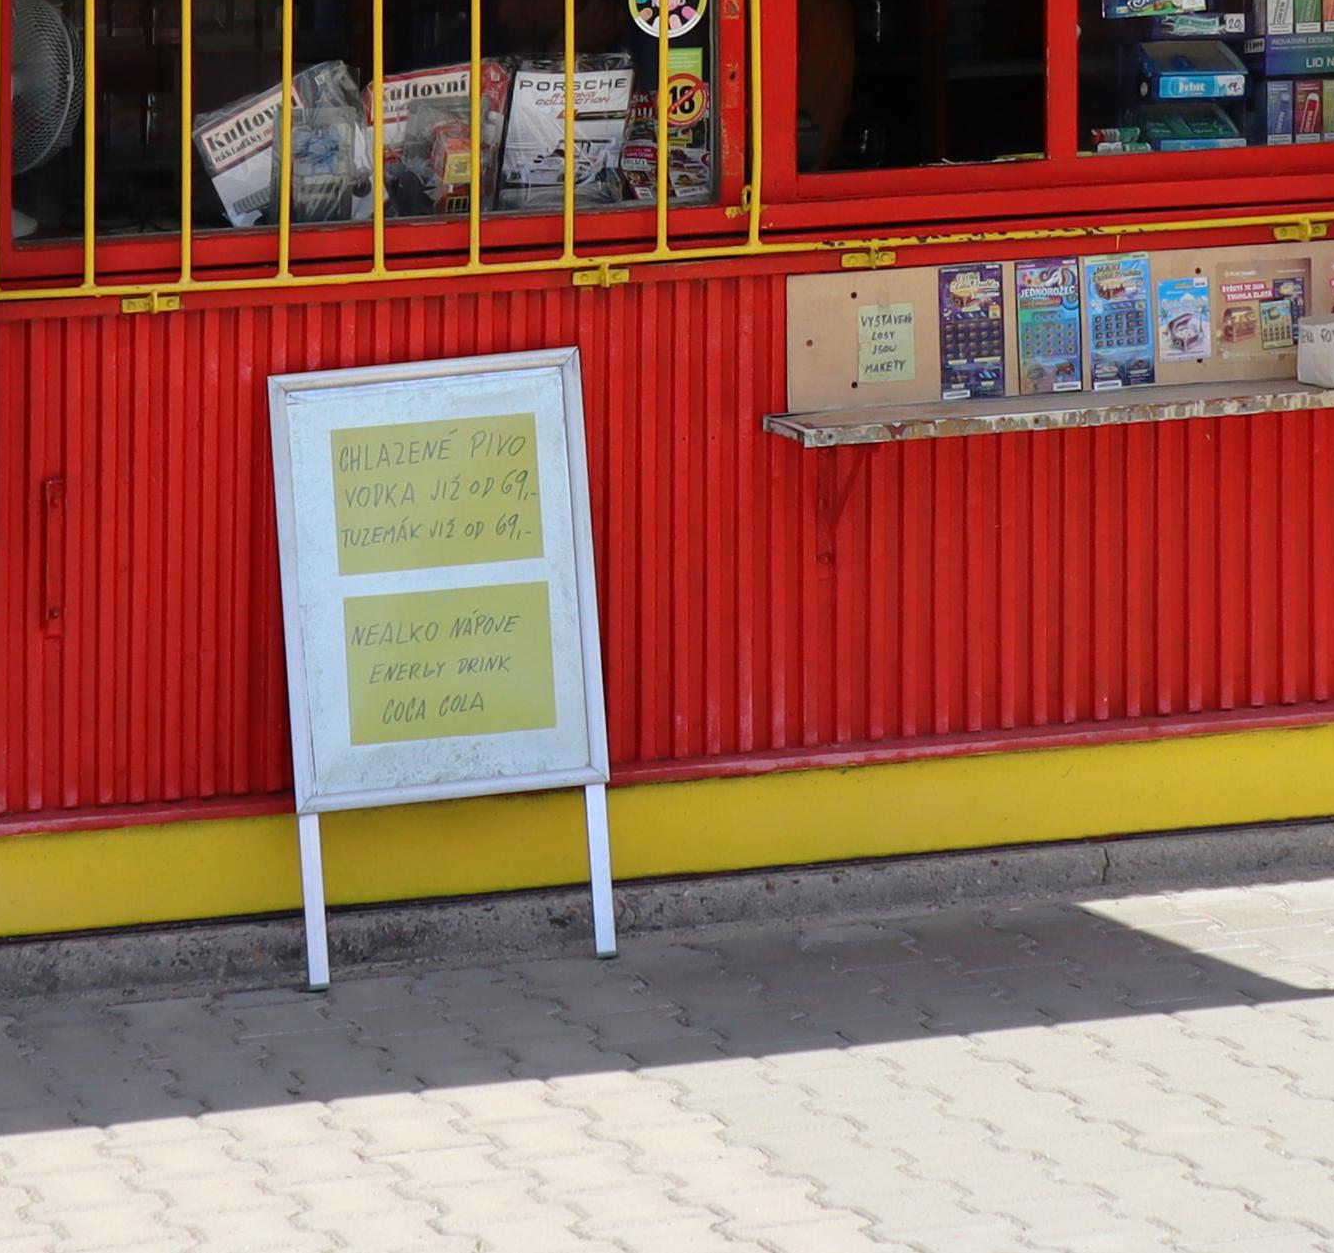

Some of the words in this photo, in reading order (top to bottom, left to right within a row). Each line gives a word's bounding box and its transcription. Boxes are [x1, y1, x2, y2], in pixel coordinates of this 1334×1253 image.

[383, 74, 468, 102] ultovní
[519, 77, 628, 92] PORSCHE
[535, 96, 611, 106] COLLCTION
[669, 85, 696, 116] 18
[1020, 285, 1076, 299] JEDNOROŽEC
[871, 330, 896, 341] LOSY
[872, 344, 897, 356] JSOU
[864, 359, 907, 374] MAKETY
[339, 429, 458, 471] CHLAZENÉ
[470, 431, 526, 459] PIVO
[344, 478, 415, 508] VODKA
[430, 475, 460, 502] JIŽ
[470, 477, 494, 499] OD
[341, 517, 420, 547] TUZEMÁK
[430, 517, 456, 540] JIŽ
[464, 521, 485, 538] OD
[351, 621, 439, 647] NEALKO
[450, 610, 521, 637] NÁPOJE
[369, 659, 445, 685] ENERGY
[458, 654, 512, 675] DRINK
[382, 696, 427, 724] COCA
[439, 692, 484, 718] COLA
